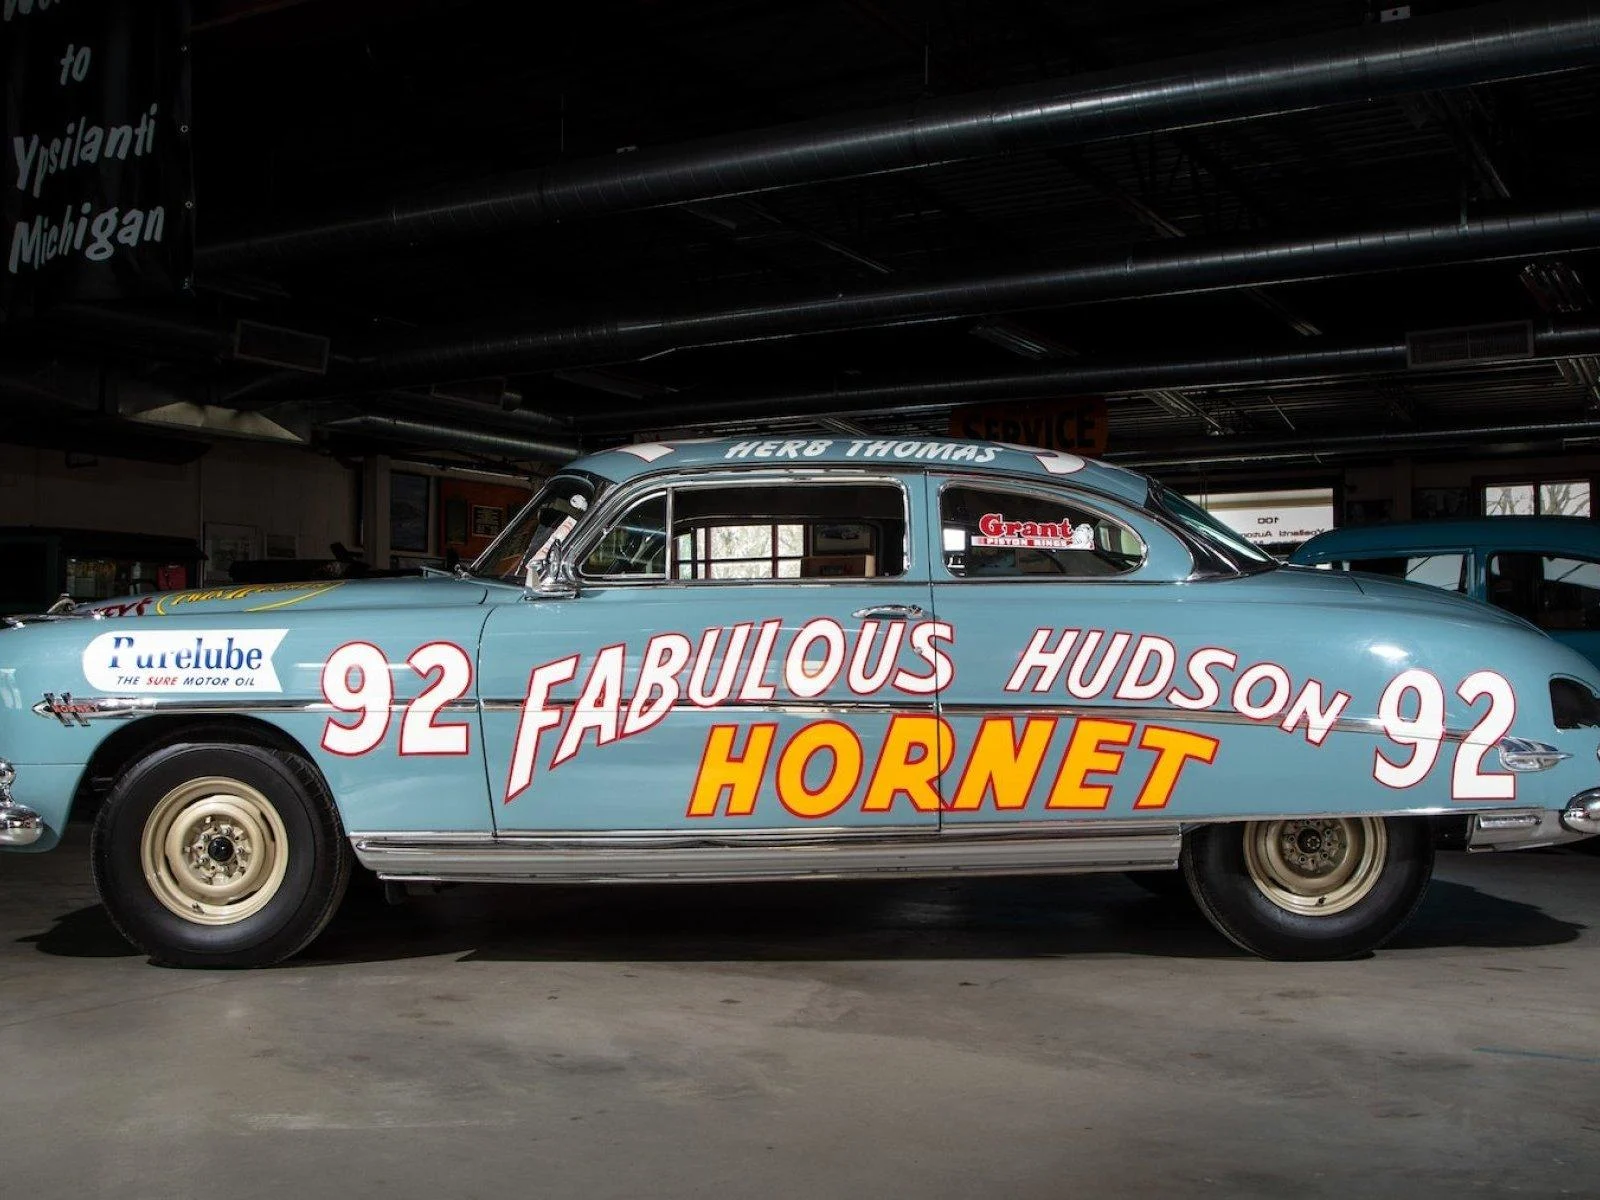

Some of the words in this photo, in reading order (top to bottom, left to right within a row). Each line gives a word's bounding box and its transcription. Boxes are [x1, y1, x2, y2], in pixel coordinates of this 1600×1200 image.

[60, 43, 91, 85] to
[13, 102, 158, 199] Ypsilanti
[9, 202, 165, 274] Michigan
[724, 439, 832, 459] HERB
[844, 439, 1000, 462] THOMAS
[962, 403, 1096, 448] SERVICE
[979, 513, 1072, 539] Grant
[108, 636, 262, 670] Purelube
[117, 676, 140, 686] THE
[146, 676, 178, 686] SURE
[183, 677, 229, 686] MOTOR
[235, 677, 255, 686] OIL
[320, 640, 473, 758] 92
[505, 618, 954, 803] FABULOUS
[1004, 628, 1351, 746] HUDSON
[1373, 668, 1516, 800] 92
[686, 714, 1219, 819] HORNET
